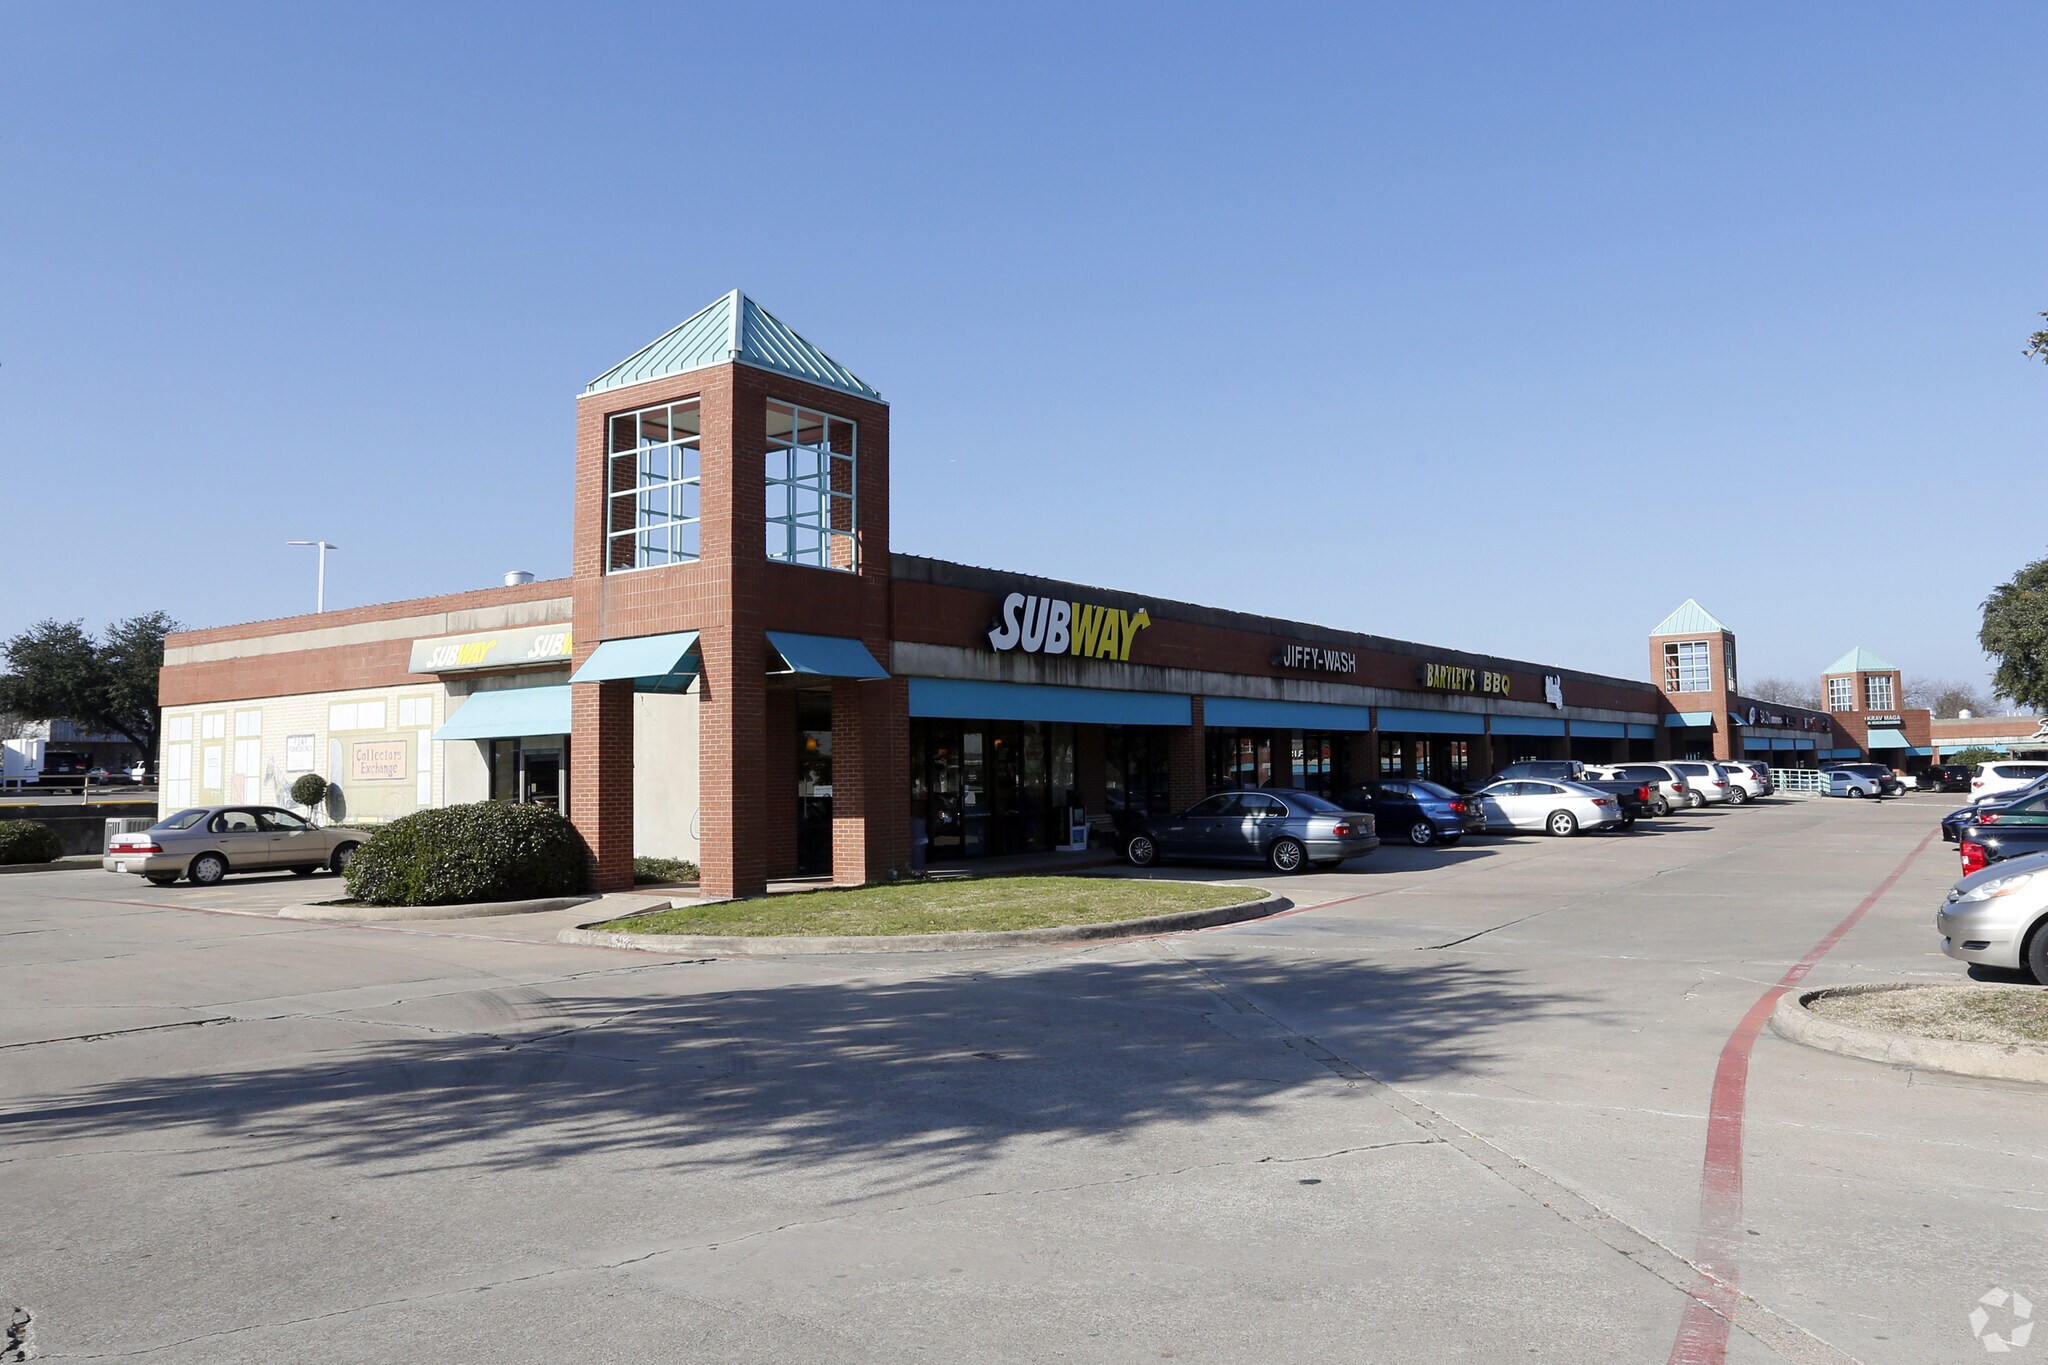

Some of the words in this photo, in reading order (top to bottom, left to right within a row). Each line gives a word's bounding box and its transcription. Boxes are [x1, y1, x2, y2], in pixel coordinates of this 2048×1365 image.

[988, 593, 1151, 661] SUBWAY
[426, 640, 497, 668] SUBWAY
[1283, 645, 1356, 673] JIFFY-WASH
[1426, 663, 1475, 691] BARTLEY'S
[1482, 671, 1510, 696] BBQ
[356, 749, 402, 761] Collectors
[361, 762, 398, 777] Exchange
